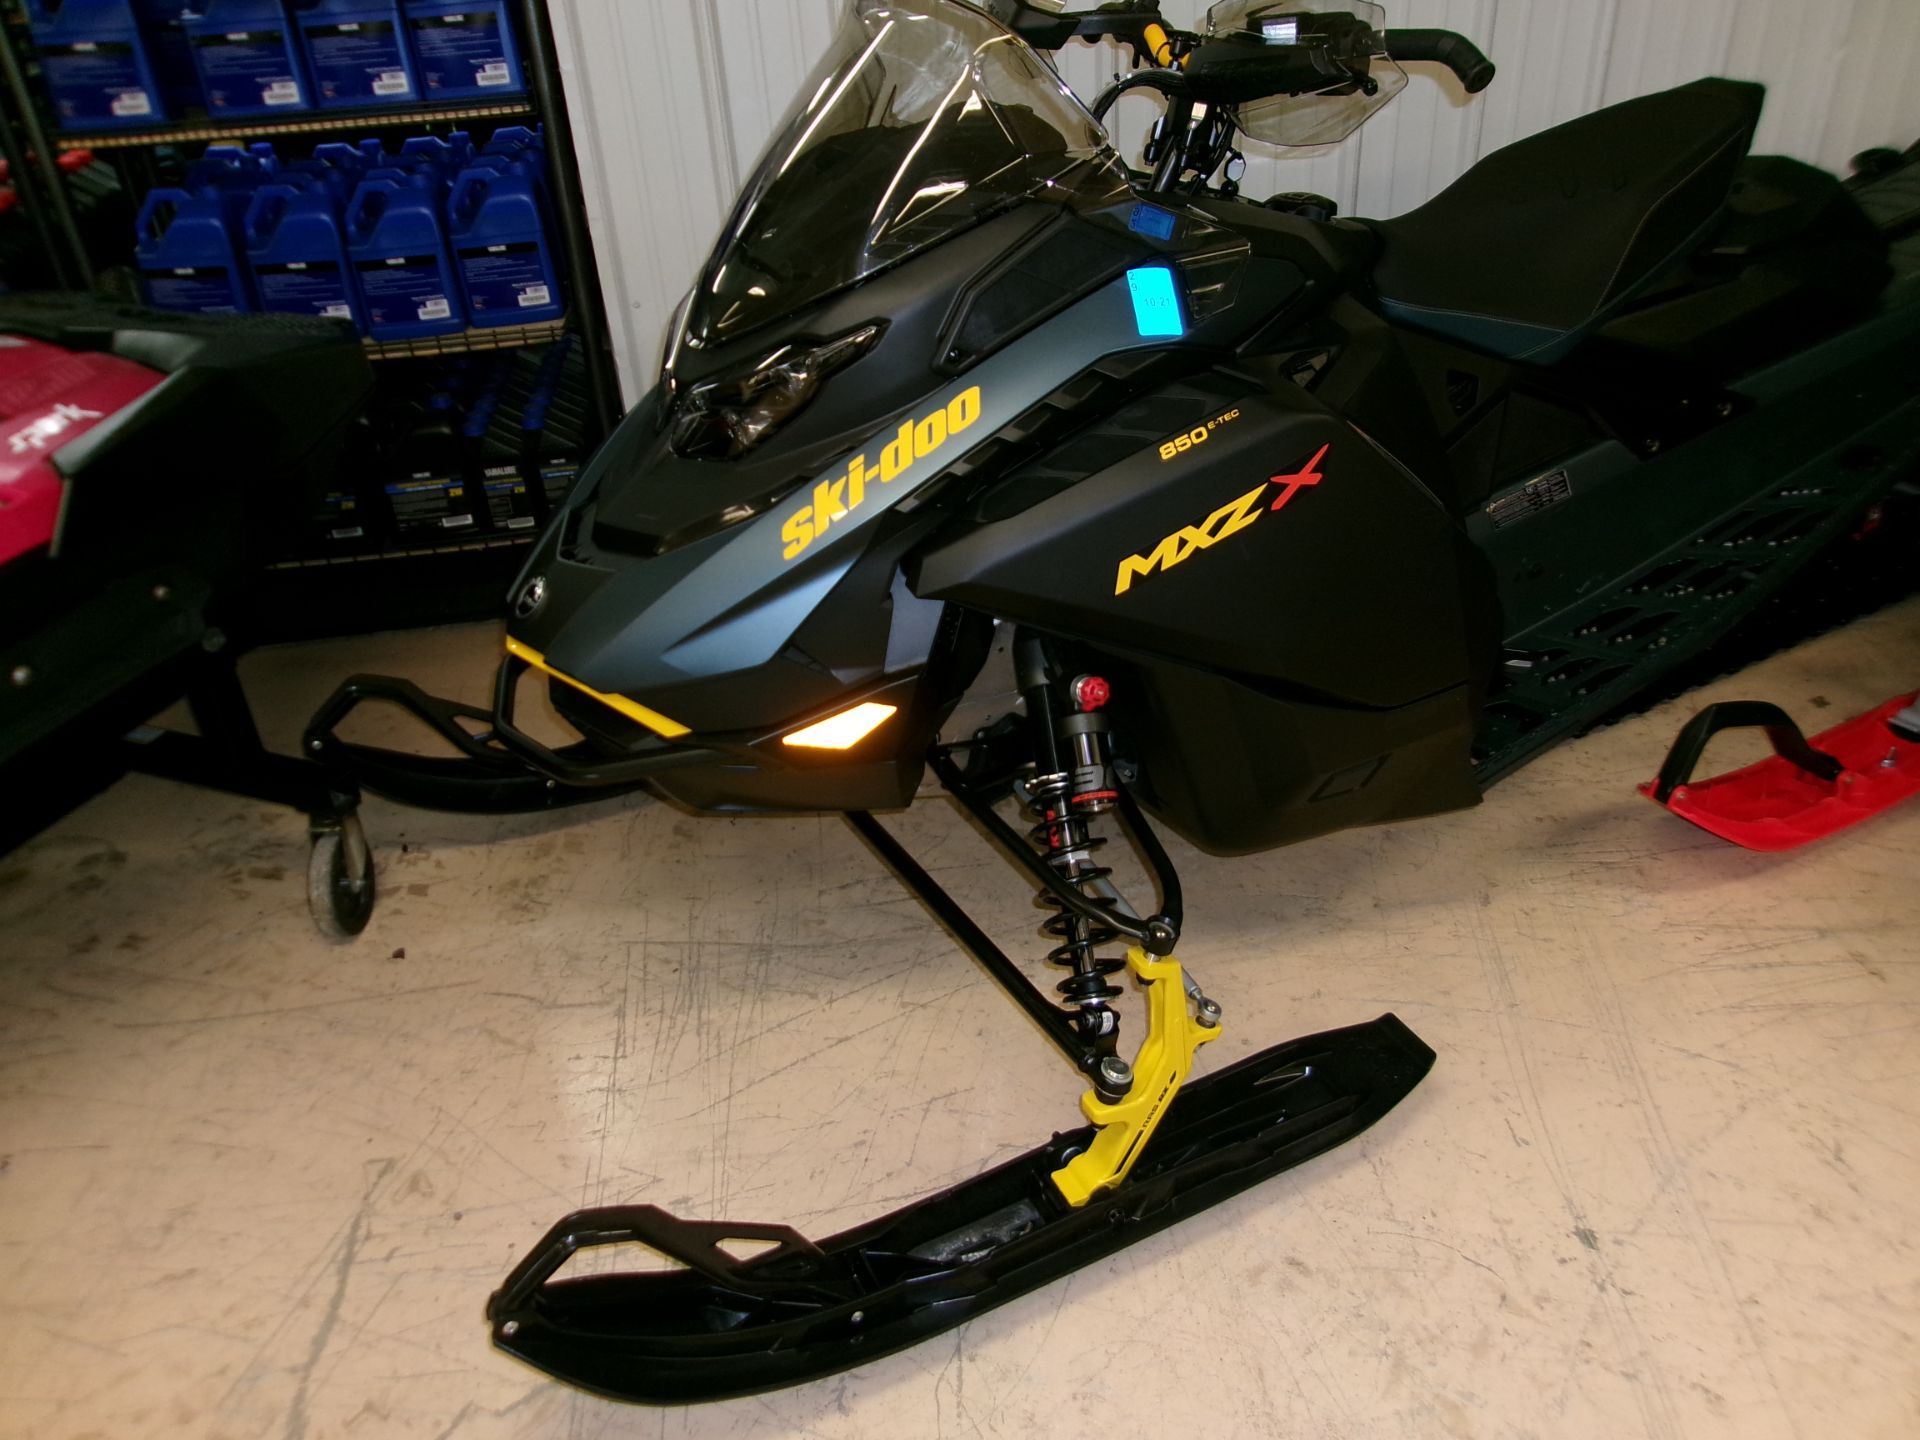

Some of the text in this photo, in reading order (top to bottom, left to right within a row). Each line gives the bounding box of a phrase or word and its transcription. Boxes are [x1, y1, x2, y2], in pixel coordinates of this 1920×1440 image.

[781, 385, 981, 560] ski-doo
[1158, 408, 1240, 460] 850 E-TEC
[1114, 443, 1330, 596] MXZ X
